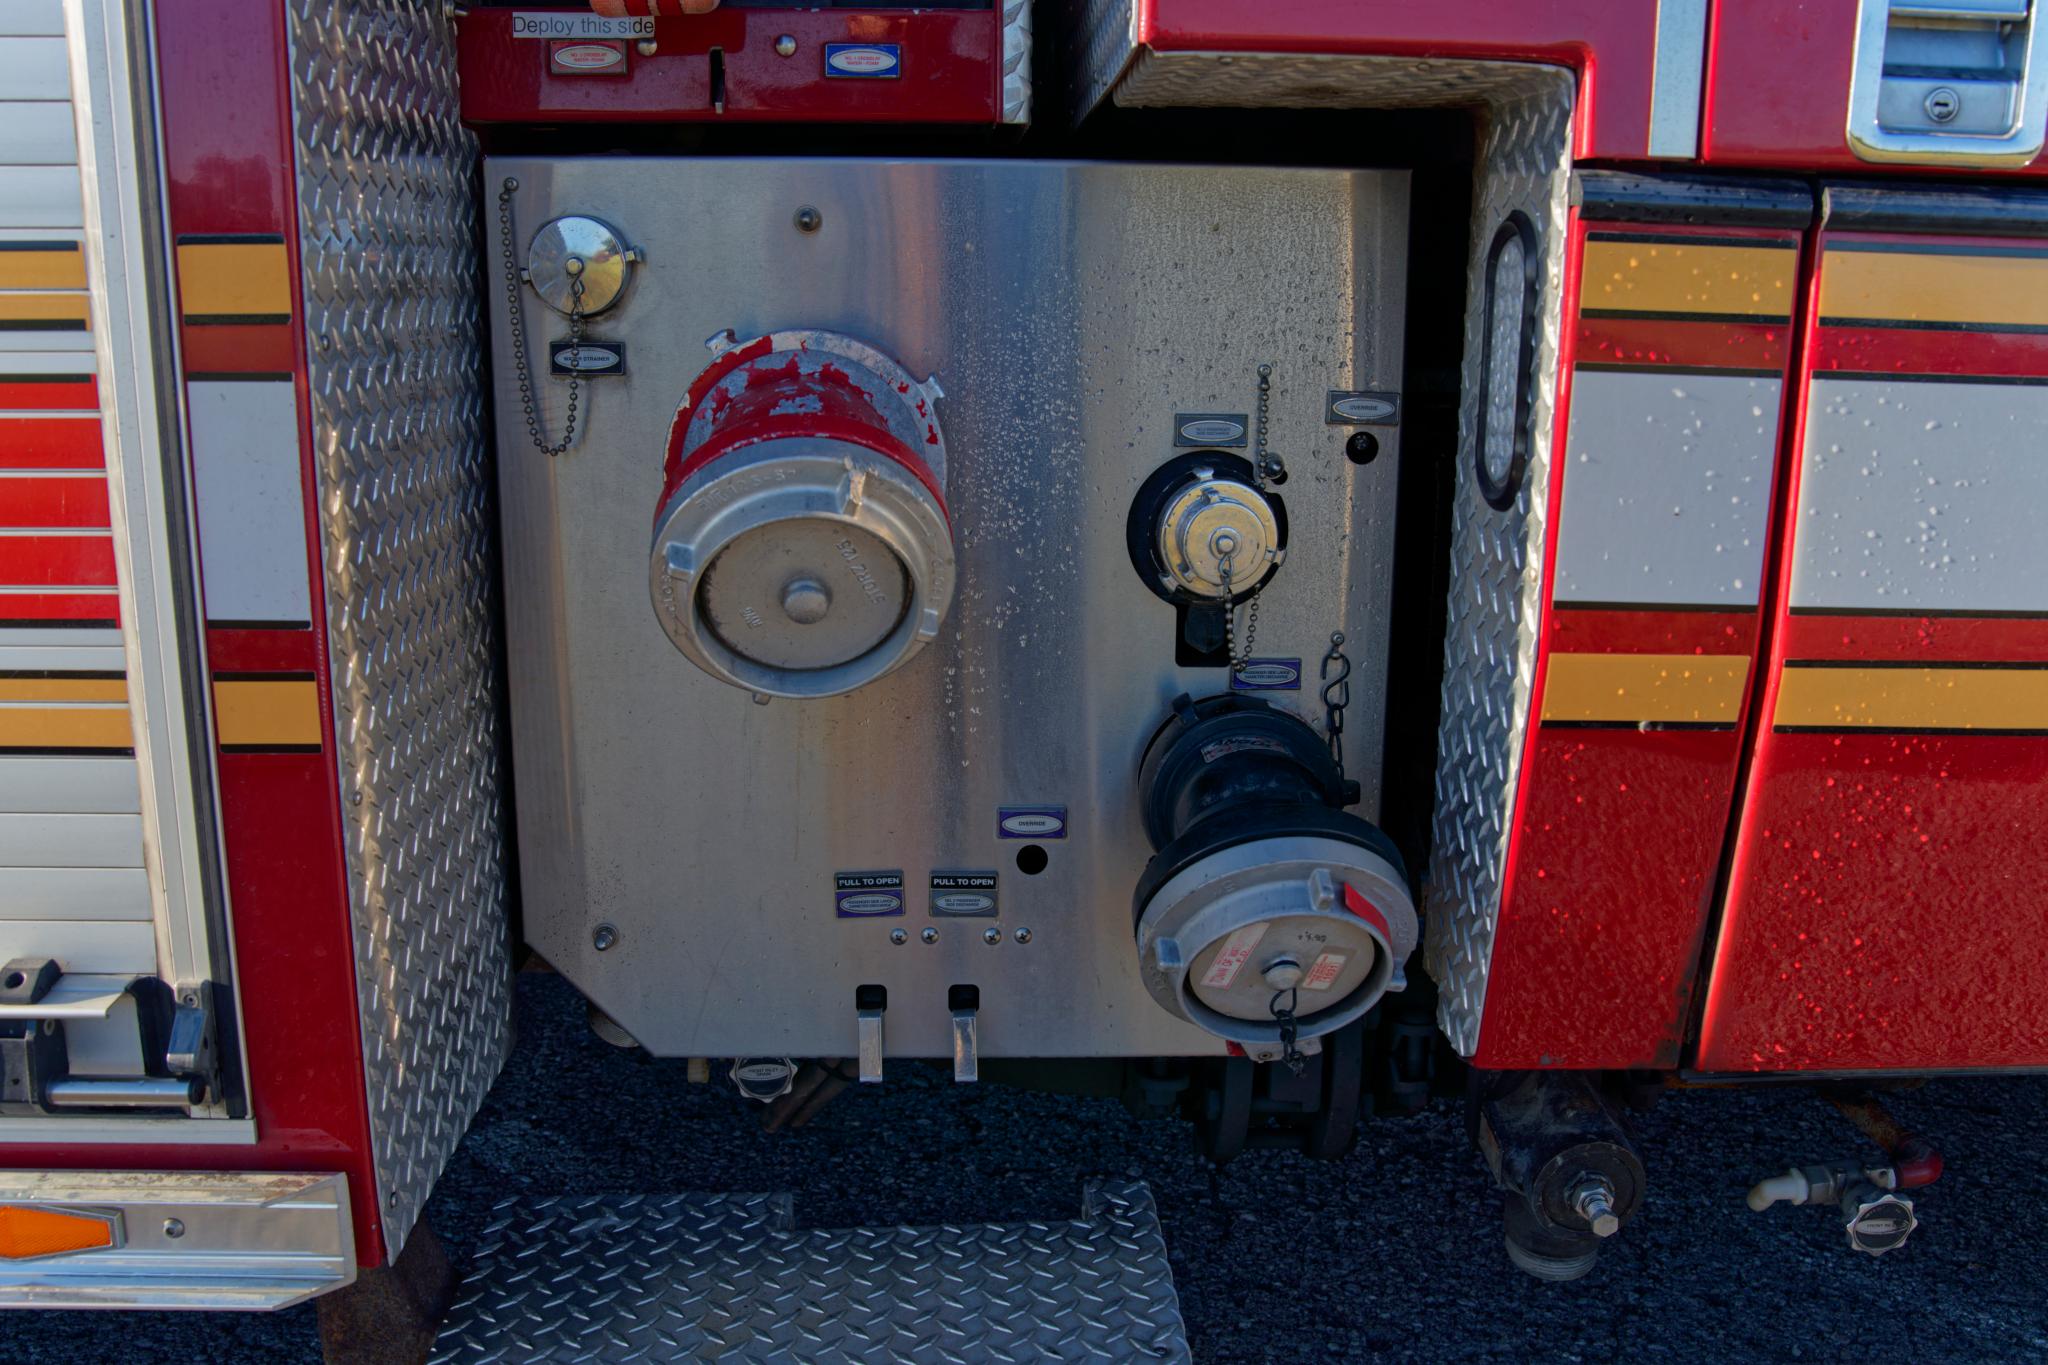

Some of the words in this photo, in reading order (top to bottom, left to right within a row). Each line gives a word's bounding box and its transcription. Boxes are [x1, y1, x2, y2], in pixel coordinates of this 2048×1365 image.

[513, 16, 575, 36] Deploy
[581, 16, 612, 34] this
[617, 16, 654, 34] side
[836, 539, 858, 562] 125
[850, 565, 888, 605] STORZ
[839, 879, 861, 887] PULL
[876, 877, 900, 885] OPEN
[933, 878, 956, 886] PULL
[957, 878, 970, 886] TO
[971, 878, 994, 886] OPEN
